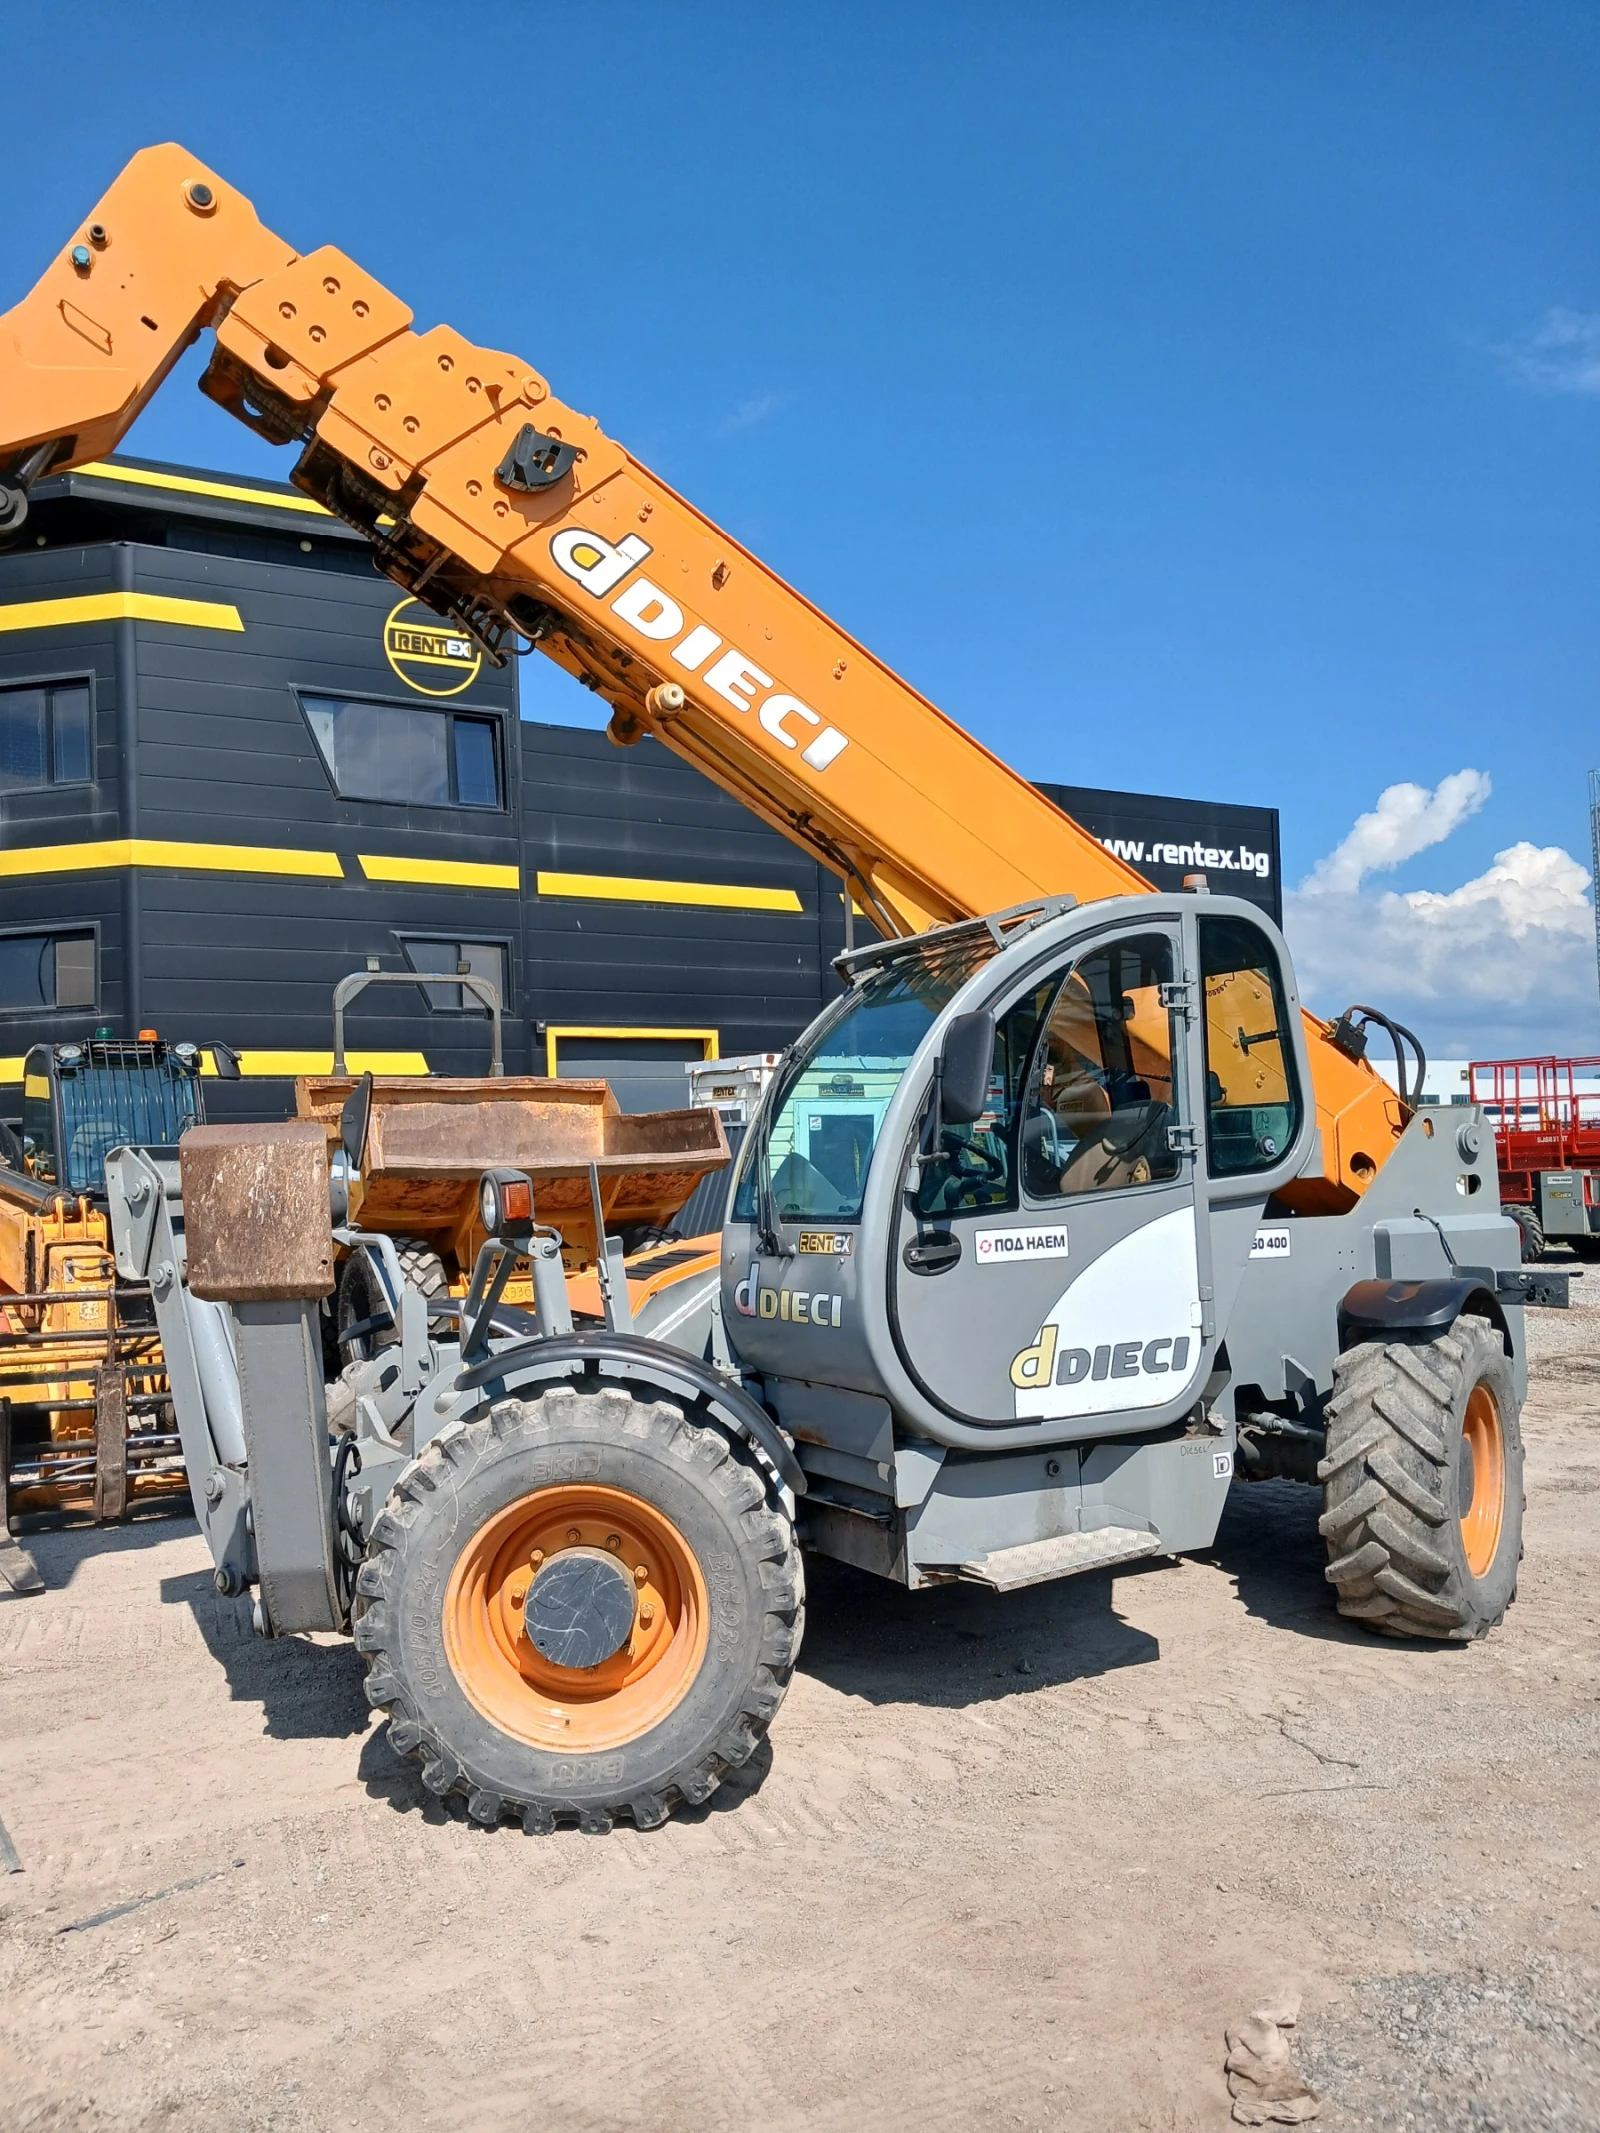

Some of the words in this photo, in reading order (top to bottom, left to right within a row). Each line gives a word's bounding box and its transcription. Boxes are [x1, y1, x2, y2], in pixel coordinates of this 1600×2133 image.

[396, 631, 471, 659] RENTEX
[1095, 837, 1270, 878] ww.rentex.bg
[800, 1233, 851, 1253] RENTEX
[994, 1237, 1025, 1253] ПОД
[1026, 1234, 1066, 1250] НАЕМ
[1266, 1236, 1288, 1249] 400
